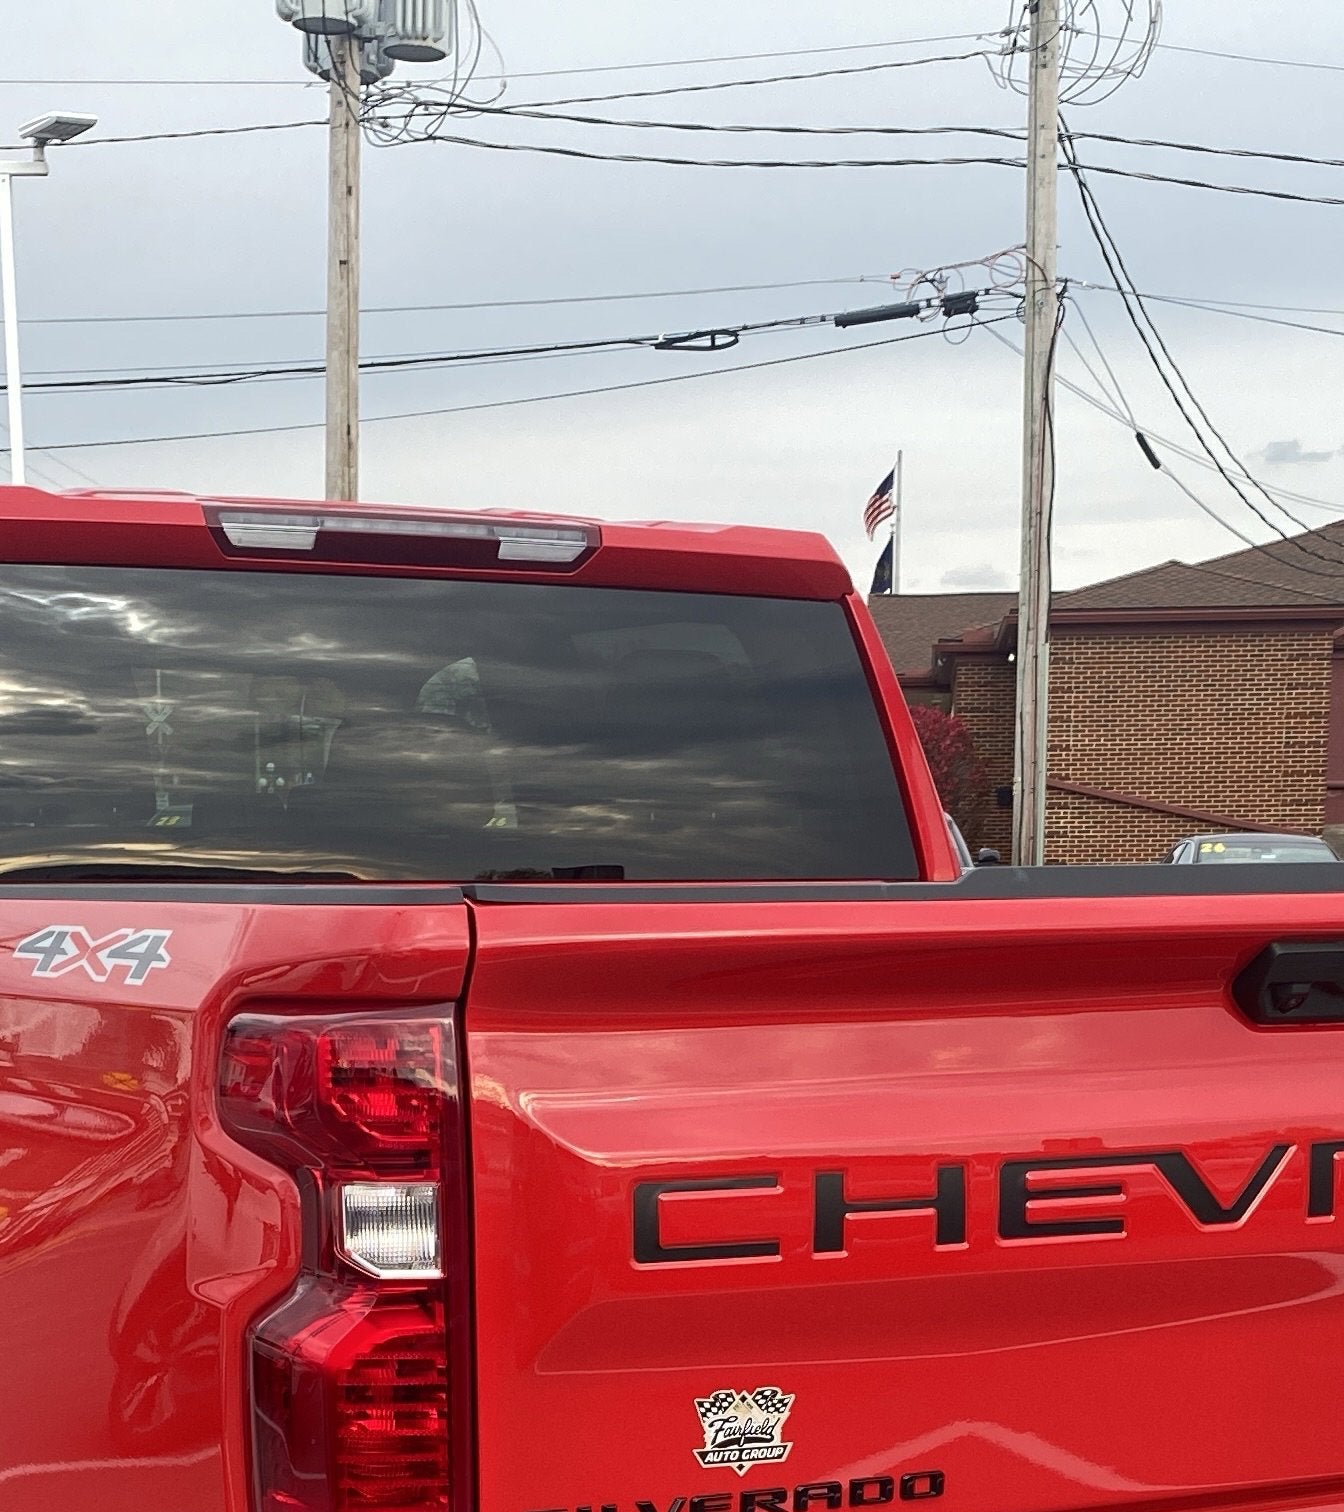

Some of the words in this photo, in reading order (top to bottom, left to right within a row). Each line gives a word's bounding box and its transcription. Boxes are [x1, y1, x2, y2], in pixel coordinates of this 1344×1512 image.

[708, 1415, 781, 1448] Fairfield
[704, 1450, 739, 1463] AUTO
[741, 1447, 784, 1460] GROUP
